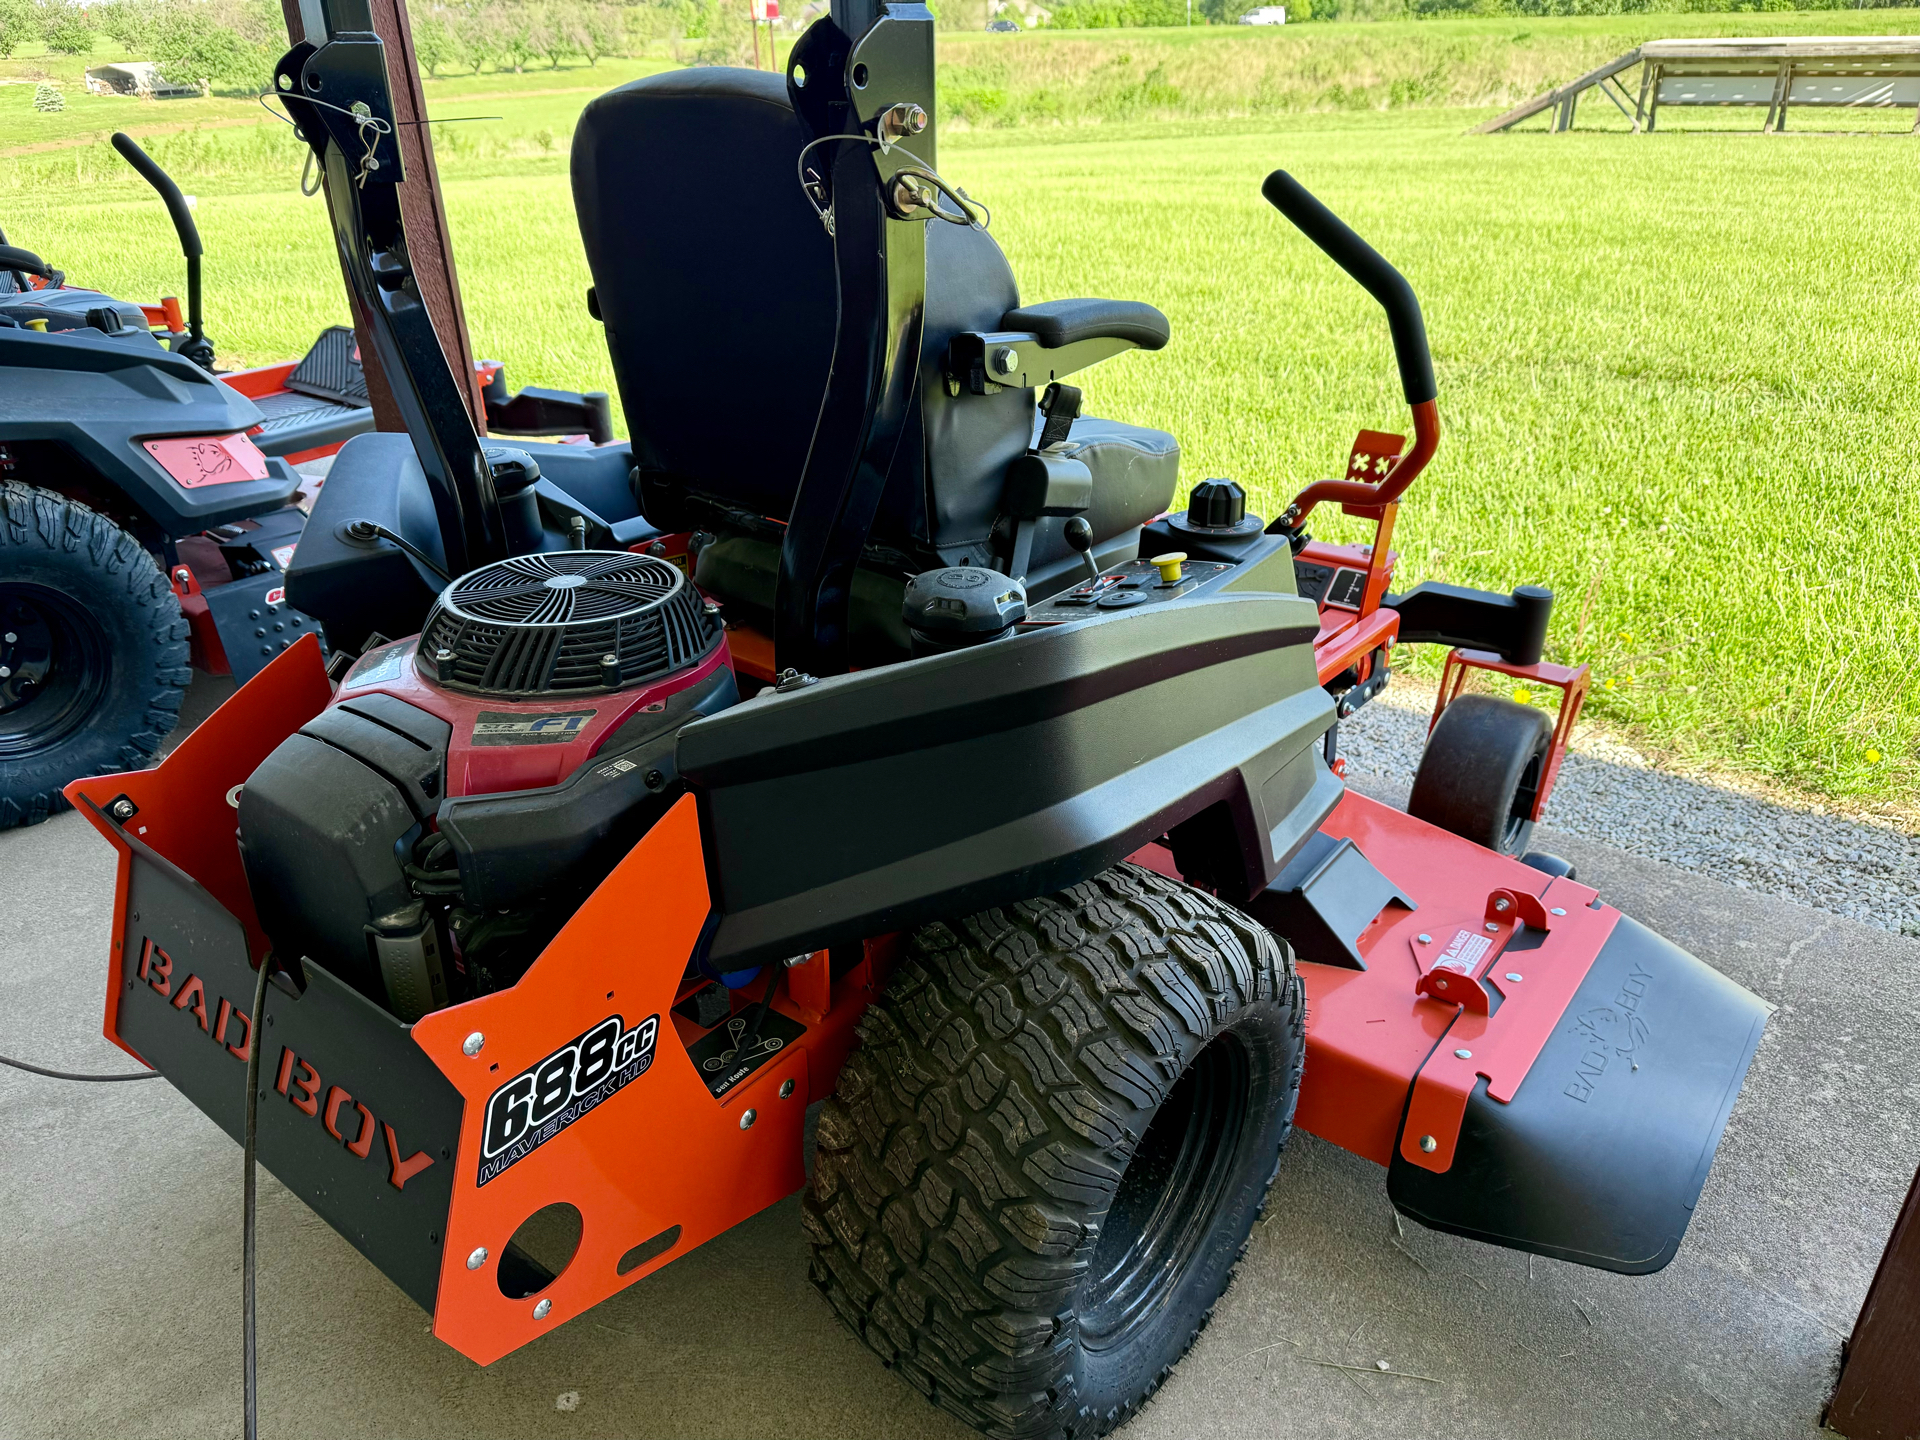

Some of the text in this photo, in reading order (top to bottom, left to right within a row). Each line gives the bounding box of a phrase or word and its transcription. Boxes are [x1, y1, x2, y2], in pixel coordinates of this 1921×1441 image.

[375, 646, 403, 680] HONDA
[529, 716, 584, 732] FI
[137, 935, 435, 1192] BAD BOY
[1563, 962, 1654, 1103] BAD BOY
[479, 1053, 652, 1185] MAVERICK HD
